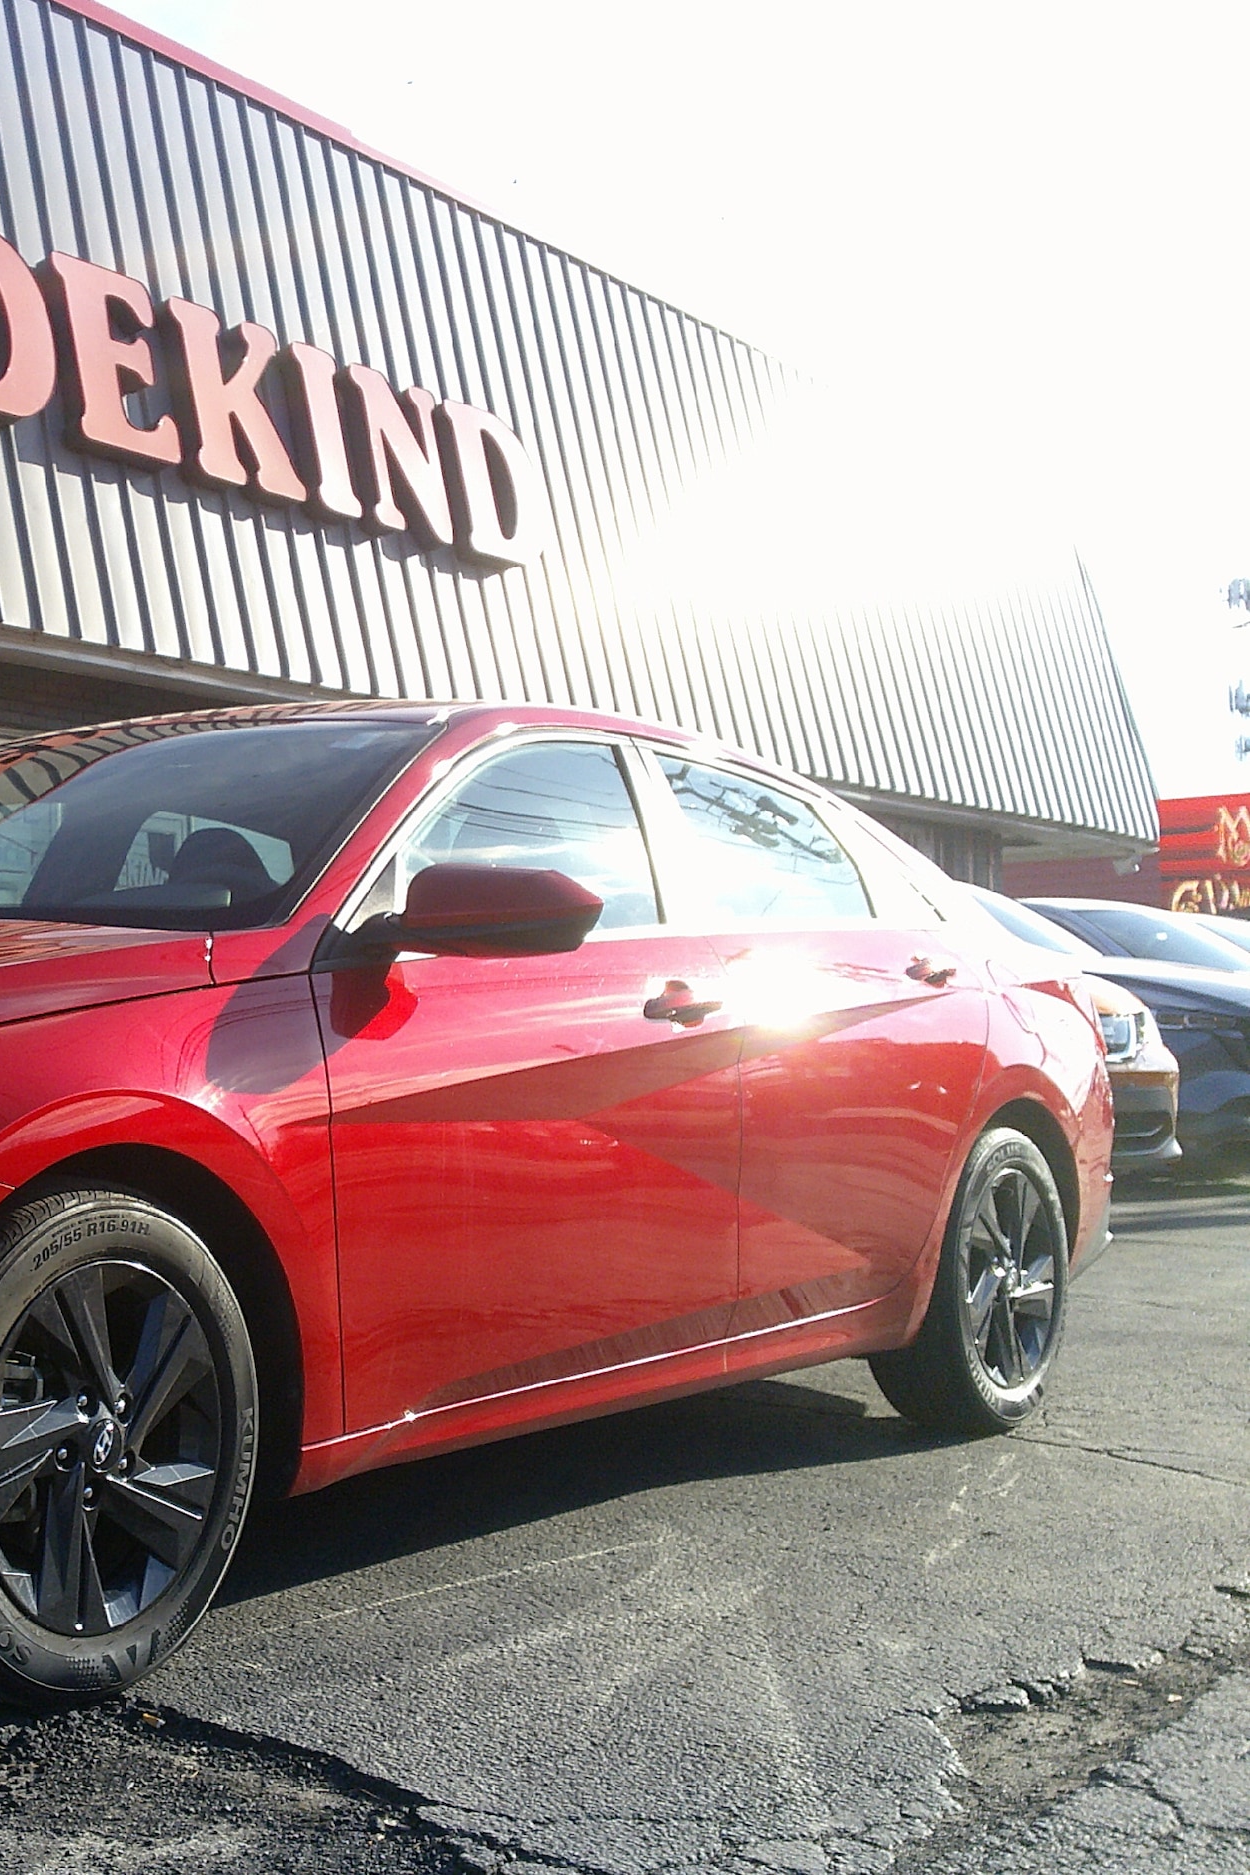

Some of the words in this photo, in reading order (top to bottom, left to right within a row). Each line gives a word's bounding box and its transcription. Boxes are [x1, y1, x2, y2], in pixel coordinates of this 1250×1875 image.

[32, 1227, 82, 1271] 205/55
[86, 1220, 116, 1237] R16
[120, 1219, 150, 1236] 91H
[220, 1407, 253, 1551] KUMHO
